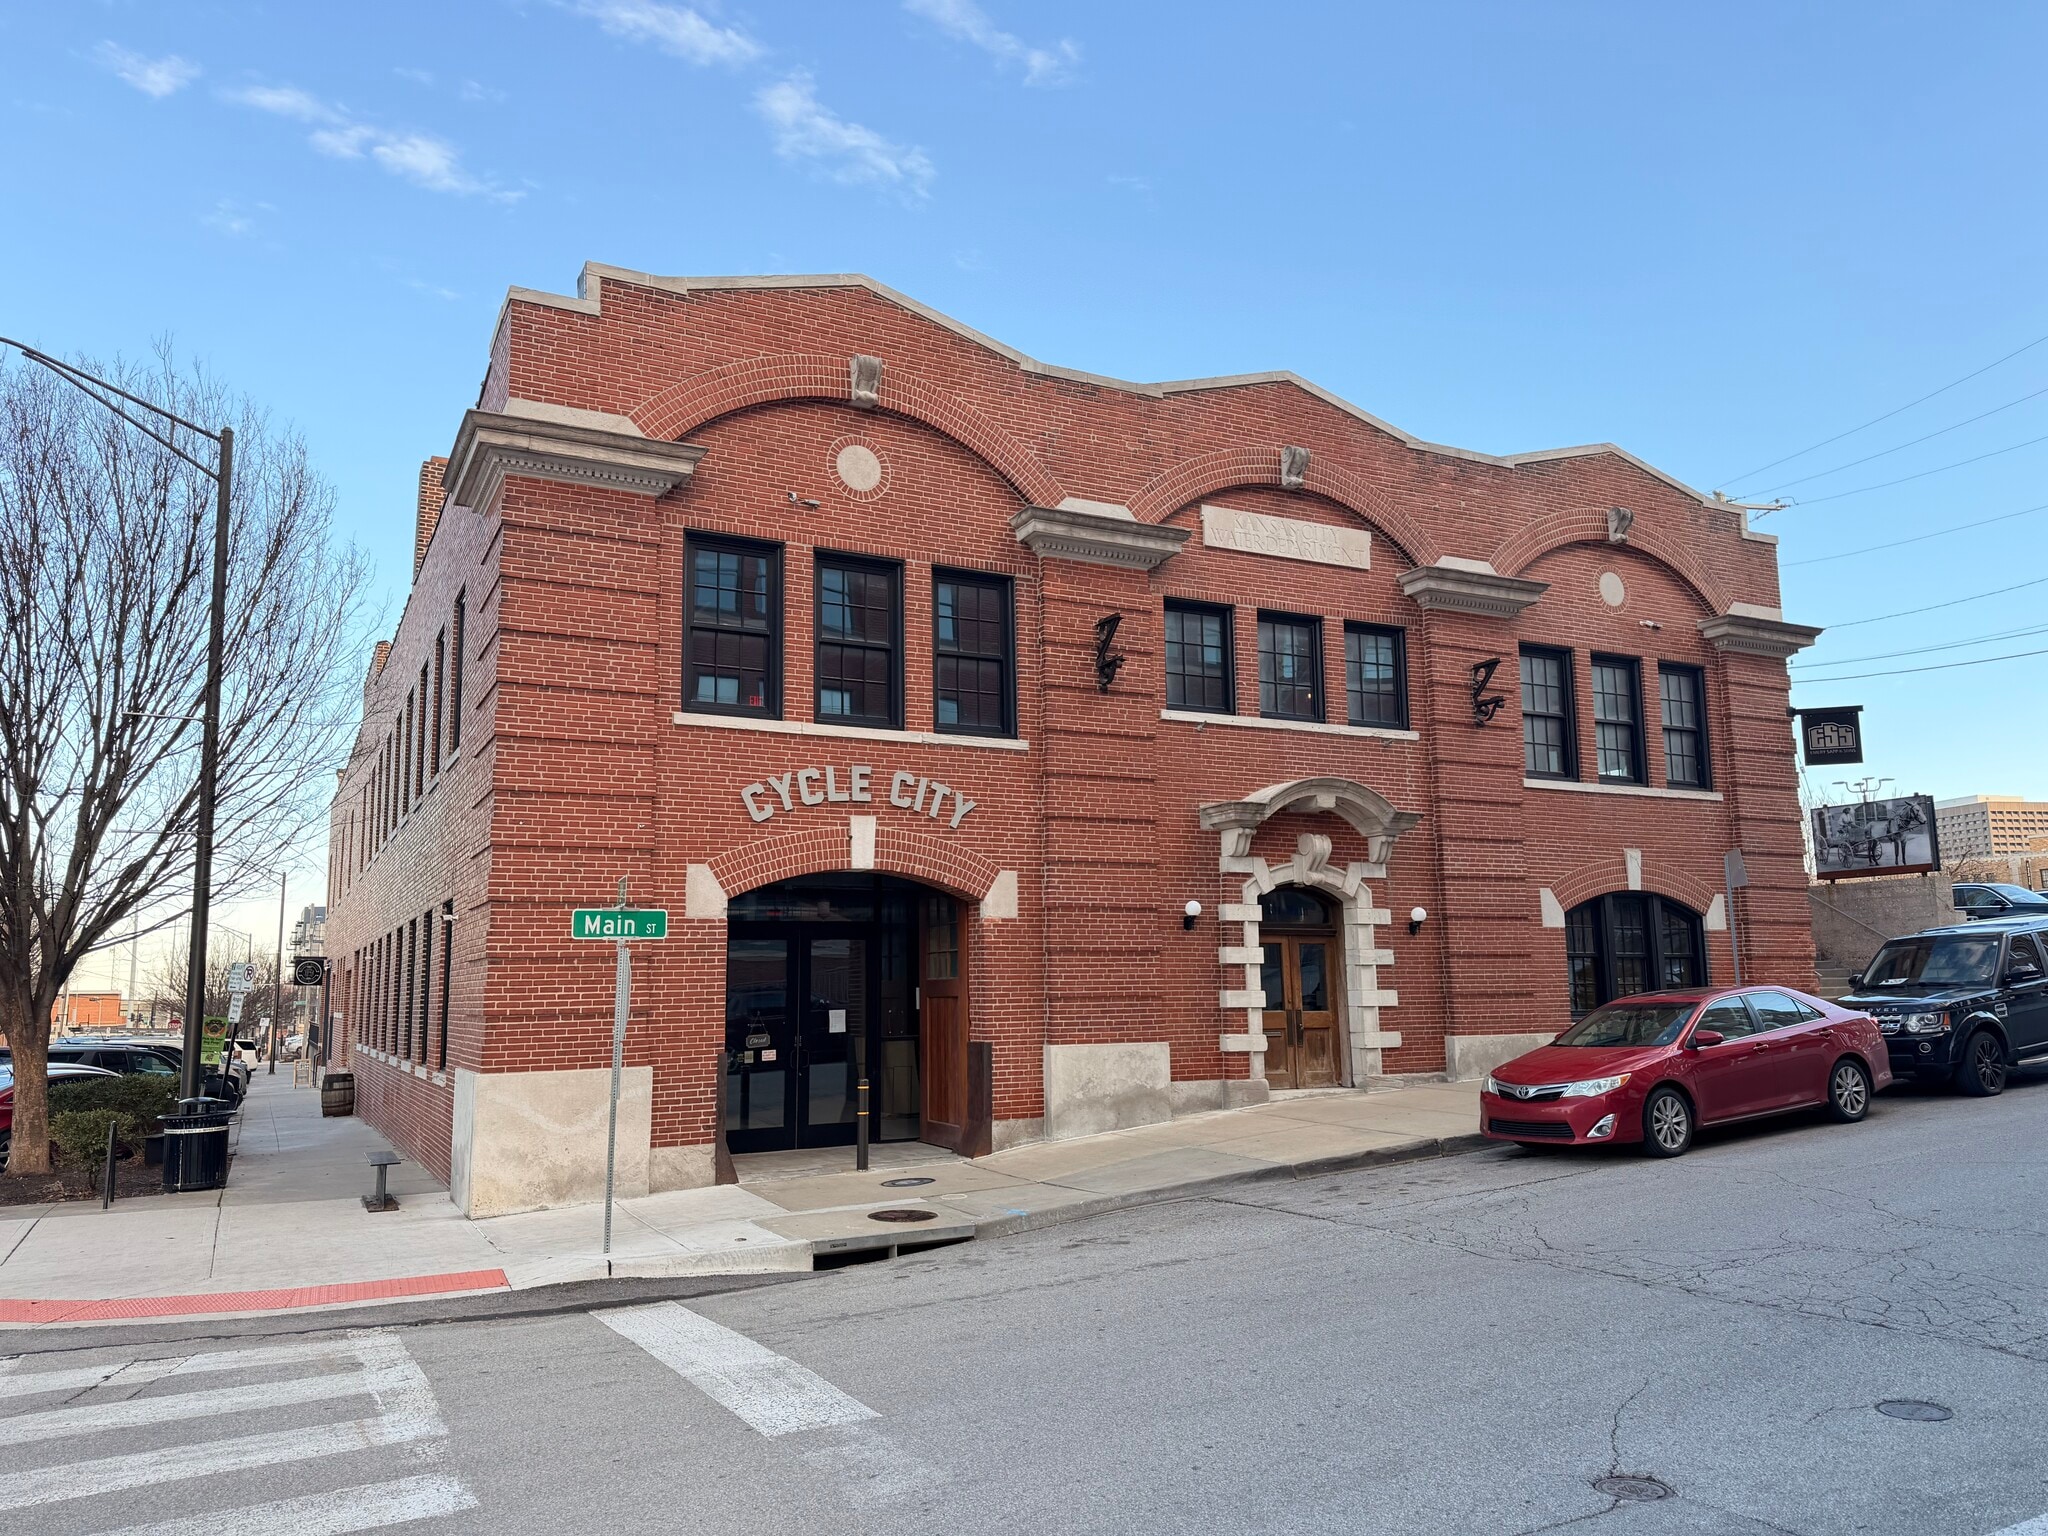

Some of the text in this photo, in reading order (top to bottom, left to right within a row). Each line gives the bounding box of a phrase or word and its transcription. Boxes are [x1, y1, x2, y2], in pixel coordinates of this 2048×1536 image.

[1235, 513, 1339, 544] KANSAS CITY
[1210, 527, 1365, 566] WATER DEPARTMENT
[1811, 724, 1853, 748] ESS
[741, 765, 978, 830] CYCLE CITY
[584, 914, 657, 935] Main ST
